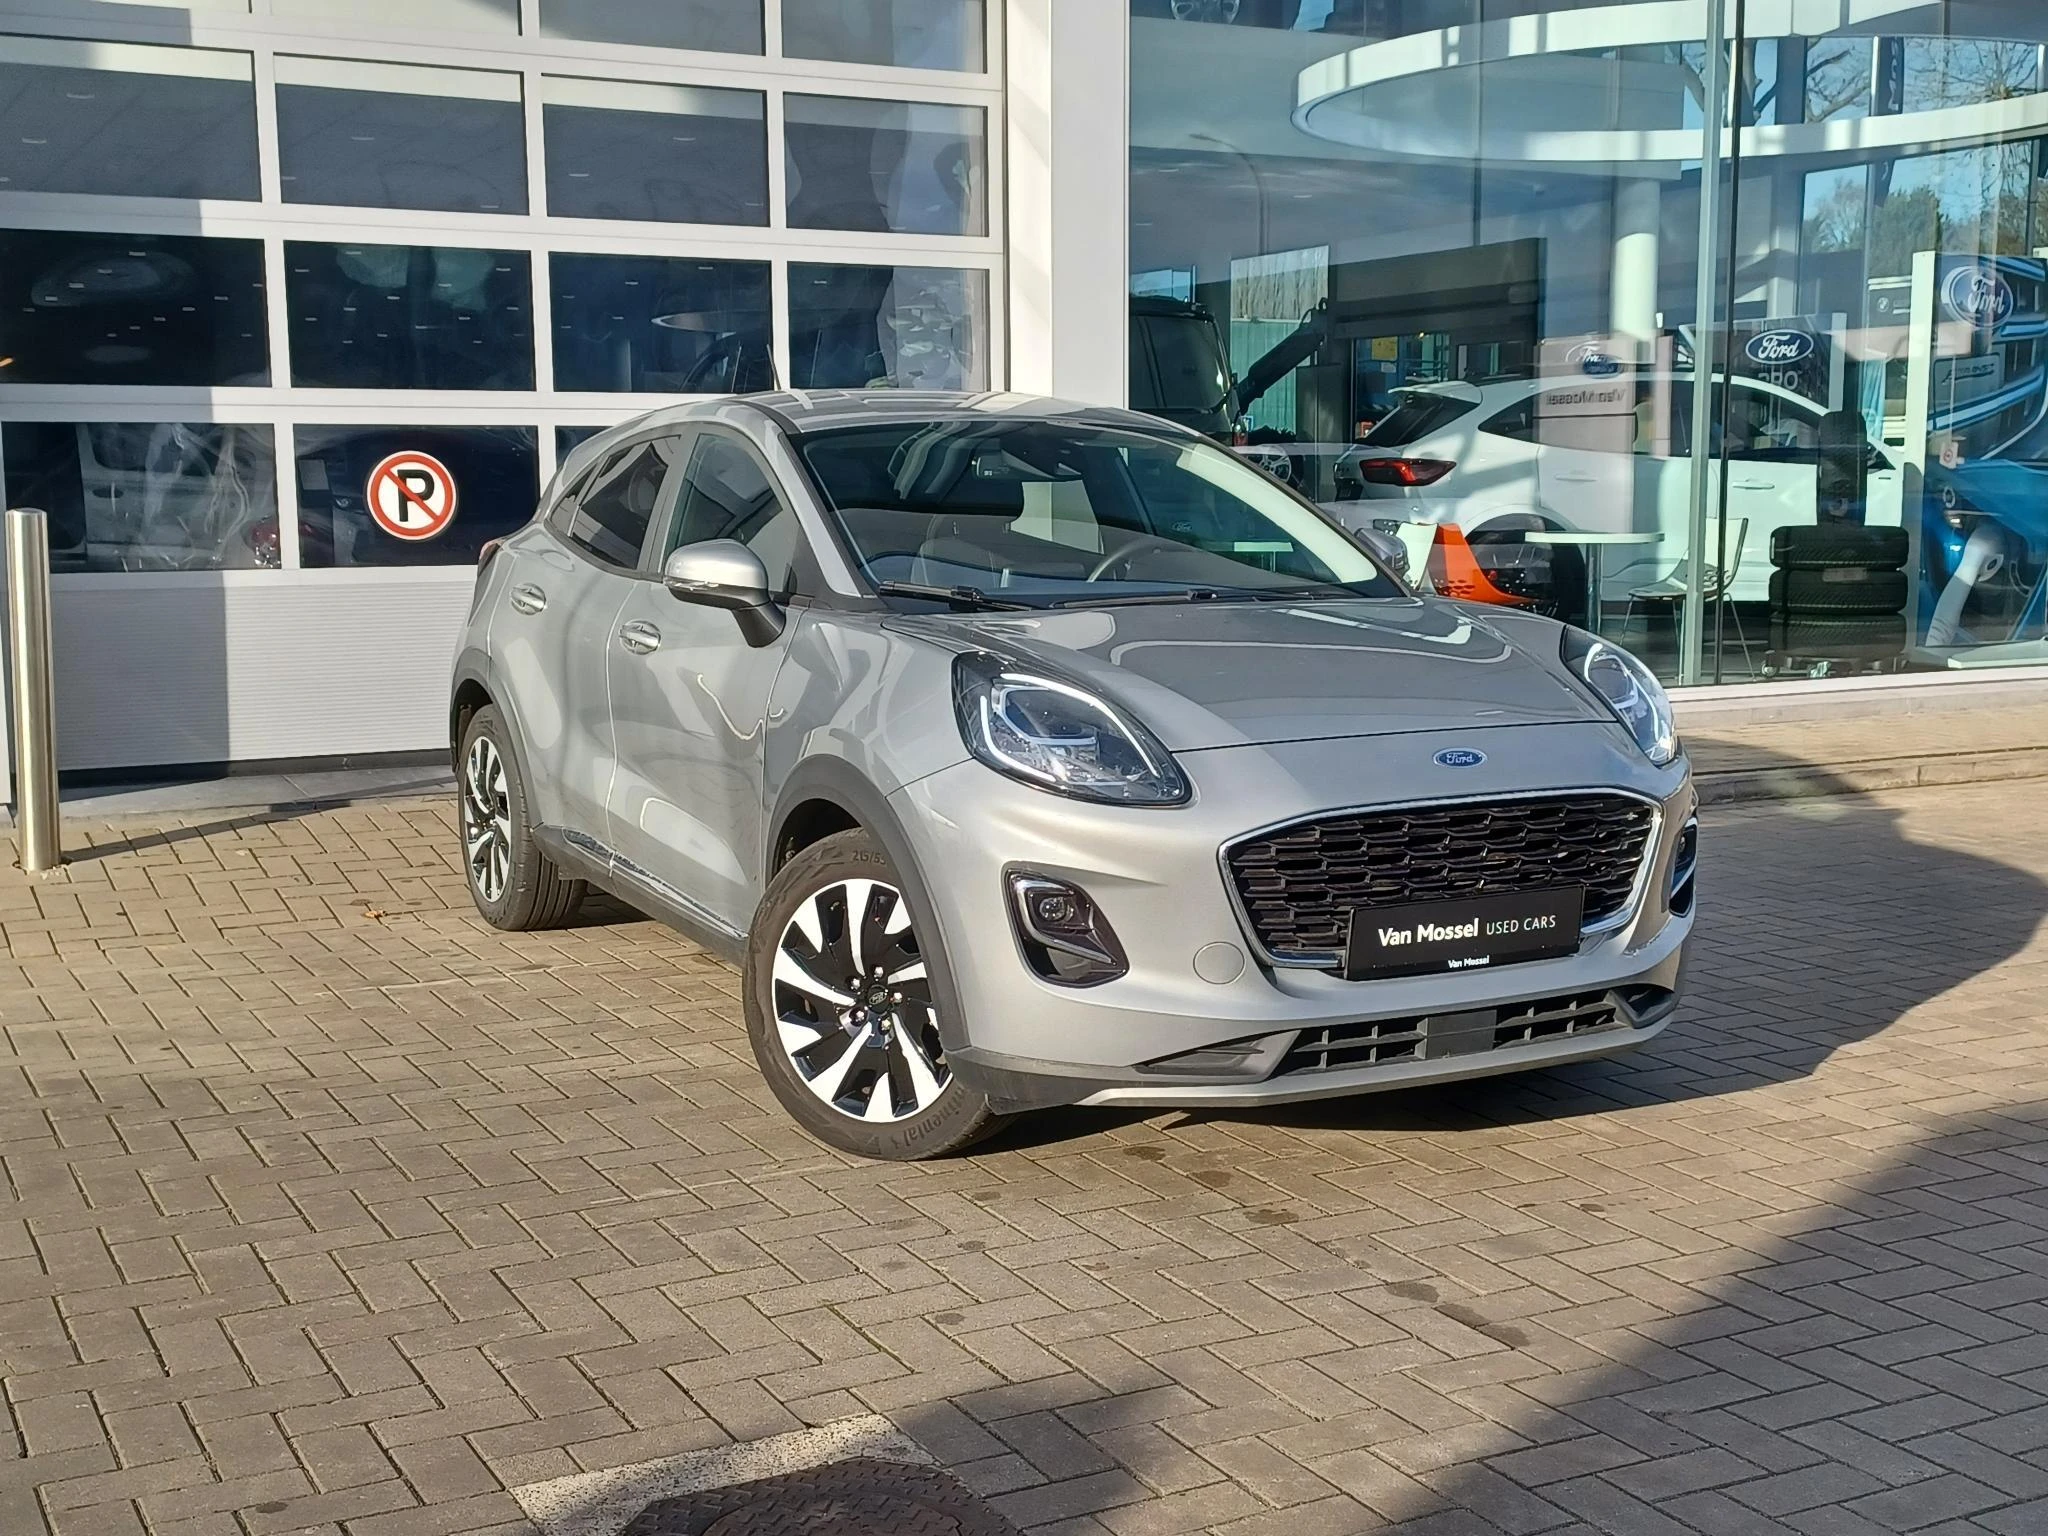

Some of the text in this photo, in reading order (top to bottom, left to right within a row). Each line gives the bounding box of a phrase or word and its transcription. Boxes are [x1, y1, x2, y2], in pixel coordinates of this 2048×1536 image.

[1758, 334, 1801, 359] Ford
[1378, 915, 1556, 947] Van Mossel USED CARS
[1448, 954, 1490, 968] Van Mossel
